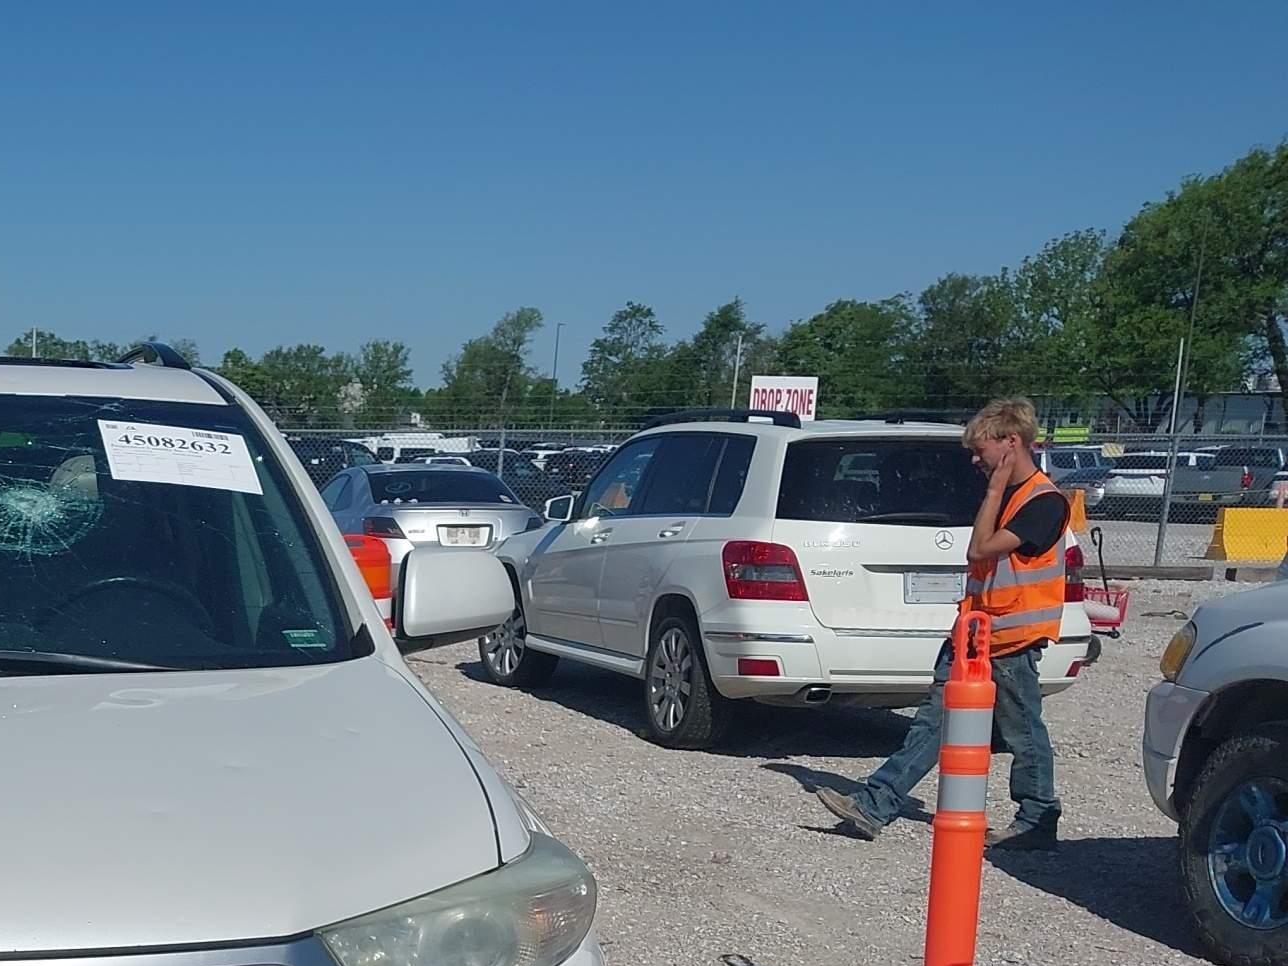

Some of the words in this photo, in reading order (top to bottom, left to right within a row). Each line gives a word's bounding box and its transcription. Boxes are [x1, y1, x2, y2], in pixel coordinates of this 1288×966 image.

[753, 388, 782, 411] DROP
[786, 389, 814, 415] ZONE
[118, 434, 232, 455] 45082632
